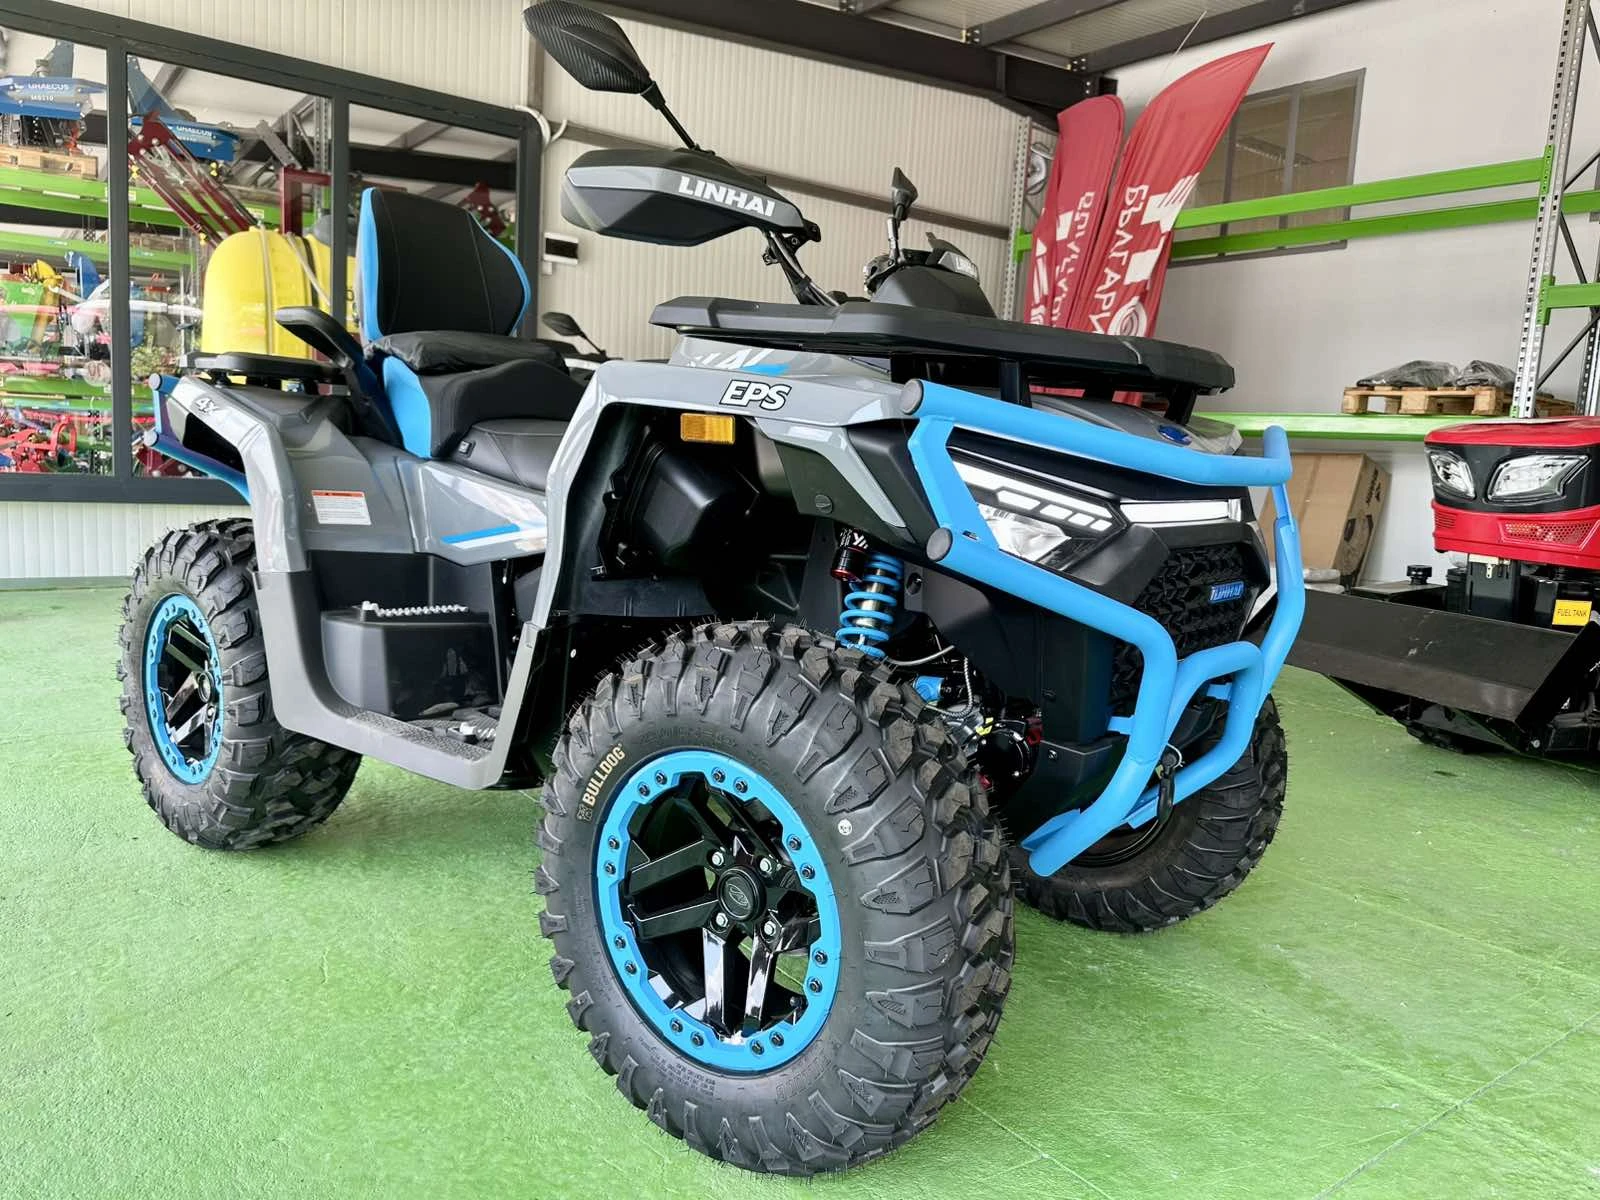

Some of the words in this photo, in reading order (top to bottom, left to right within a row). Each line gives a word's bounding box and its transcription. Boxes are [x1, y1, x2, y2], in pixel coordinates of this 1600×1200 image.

[678, 175, 776, 217] LINHAI
[719, 379, 792, 411] EPS
[1557, 608, 1571, 617] FUEL
[1573, 609, 1587, 617] TANK
[582, 746, 625, 807] BULLDOG
